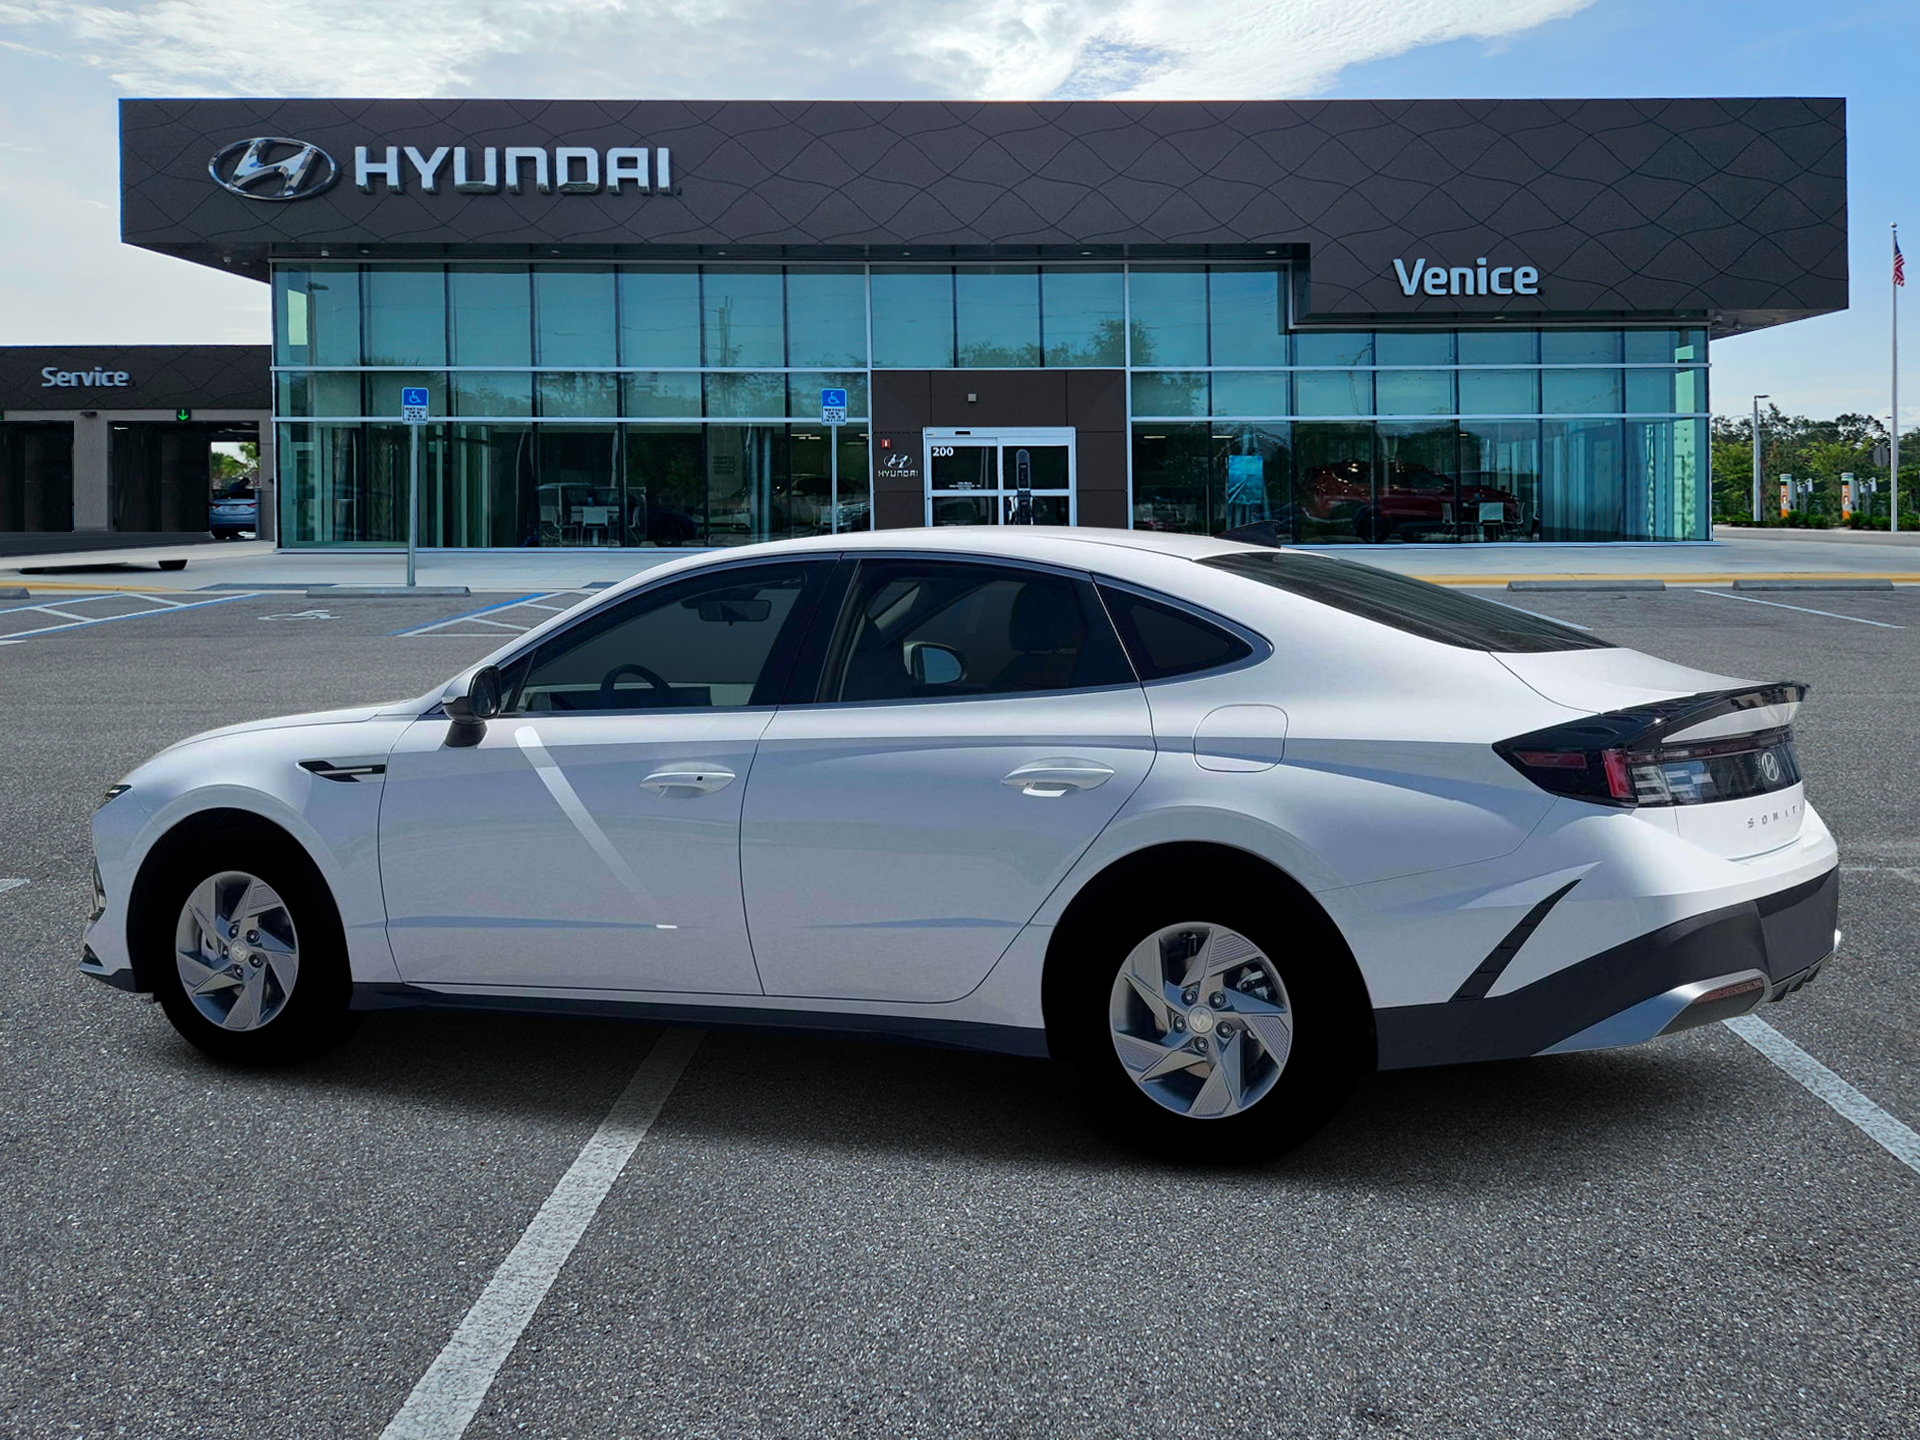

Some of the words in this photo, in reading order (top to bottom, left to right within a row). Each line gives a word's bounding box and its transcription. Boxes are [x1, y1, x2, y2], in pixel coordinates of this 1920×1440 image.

[354, 146, 670, 194] HYUNDAI
[1393, 257, 1539, 296] Venice
[41, 366, 130, 387] Service
[932, 446, 954, 457] 200
